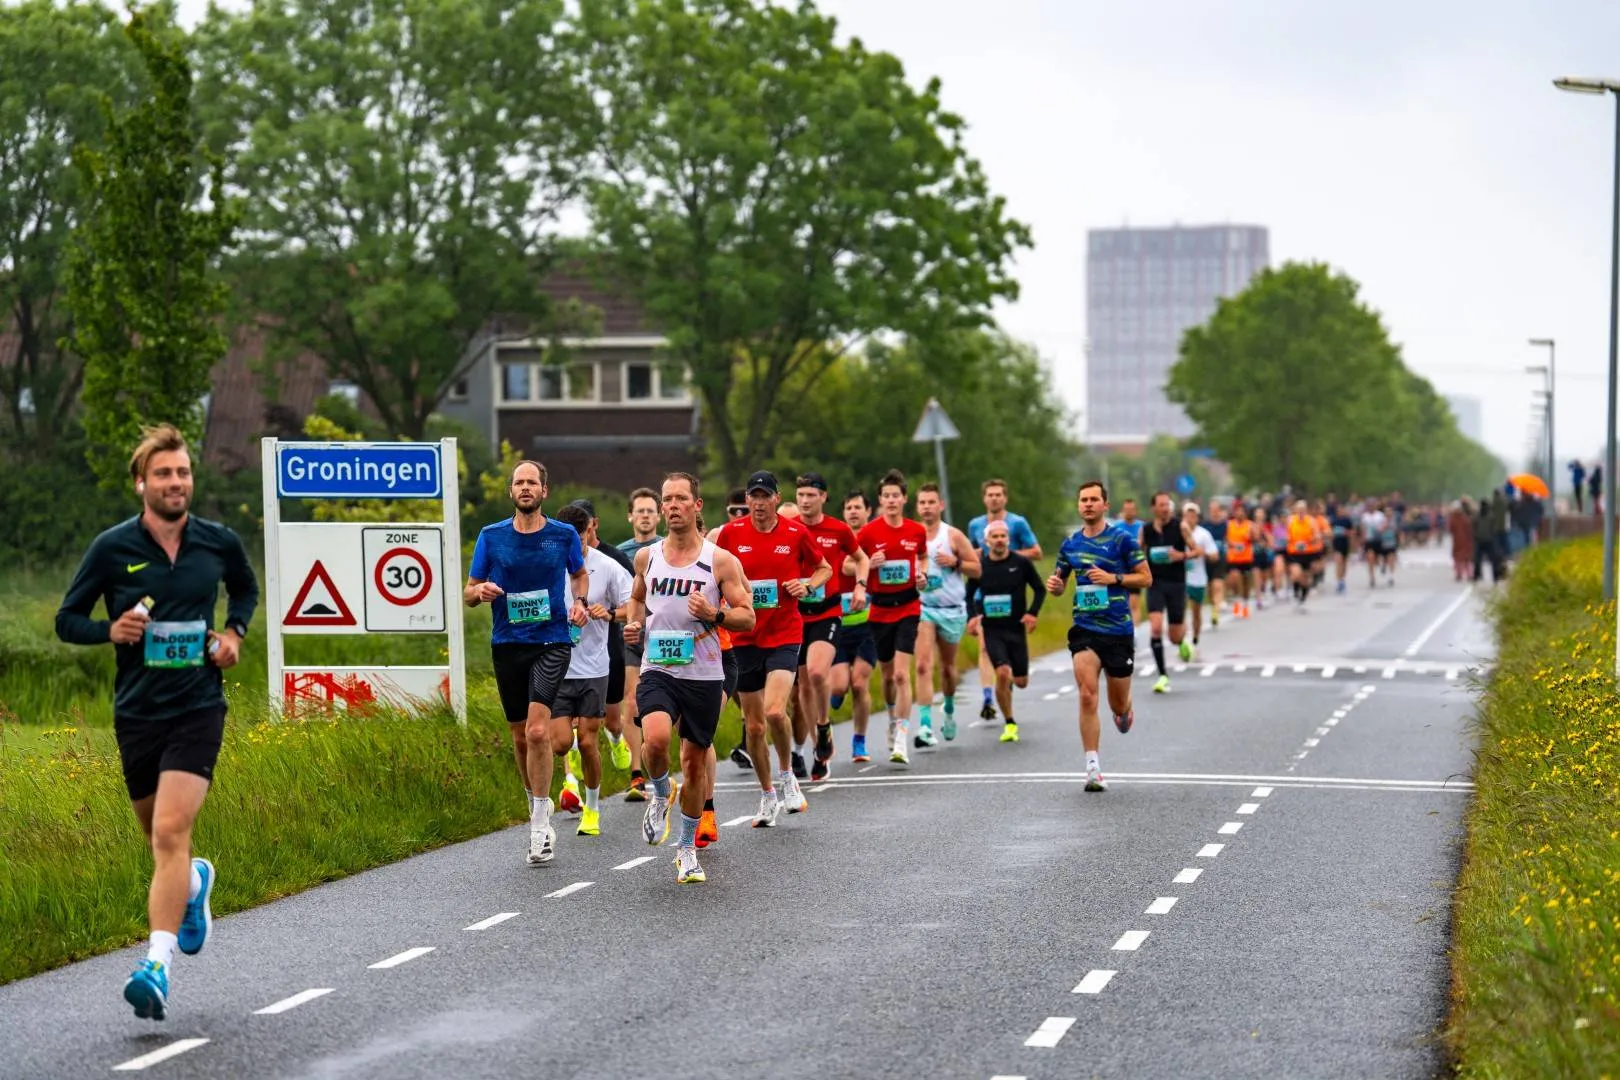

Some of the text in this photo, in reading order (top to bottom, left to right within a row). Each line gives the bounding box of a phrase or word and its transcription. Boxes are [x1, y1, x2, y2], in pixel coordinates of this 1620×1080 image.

[287, 456, 431, 488] Groningen
[386, 533, 418, 543] ZONE
[386, 566, 422, 588] 30
[651, 577, 706, 596] MIUT
[511, 598, 544, 608] DANNY
[752, 594, 768, 603] 98
[1084, 597, 1100, 606] 130
[518, 607, 540, 617] 176
[658, 639, 684, 647] ROLF
[166, 645, 188, 659] 65
[660, 647, 682, 658] 114
